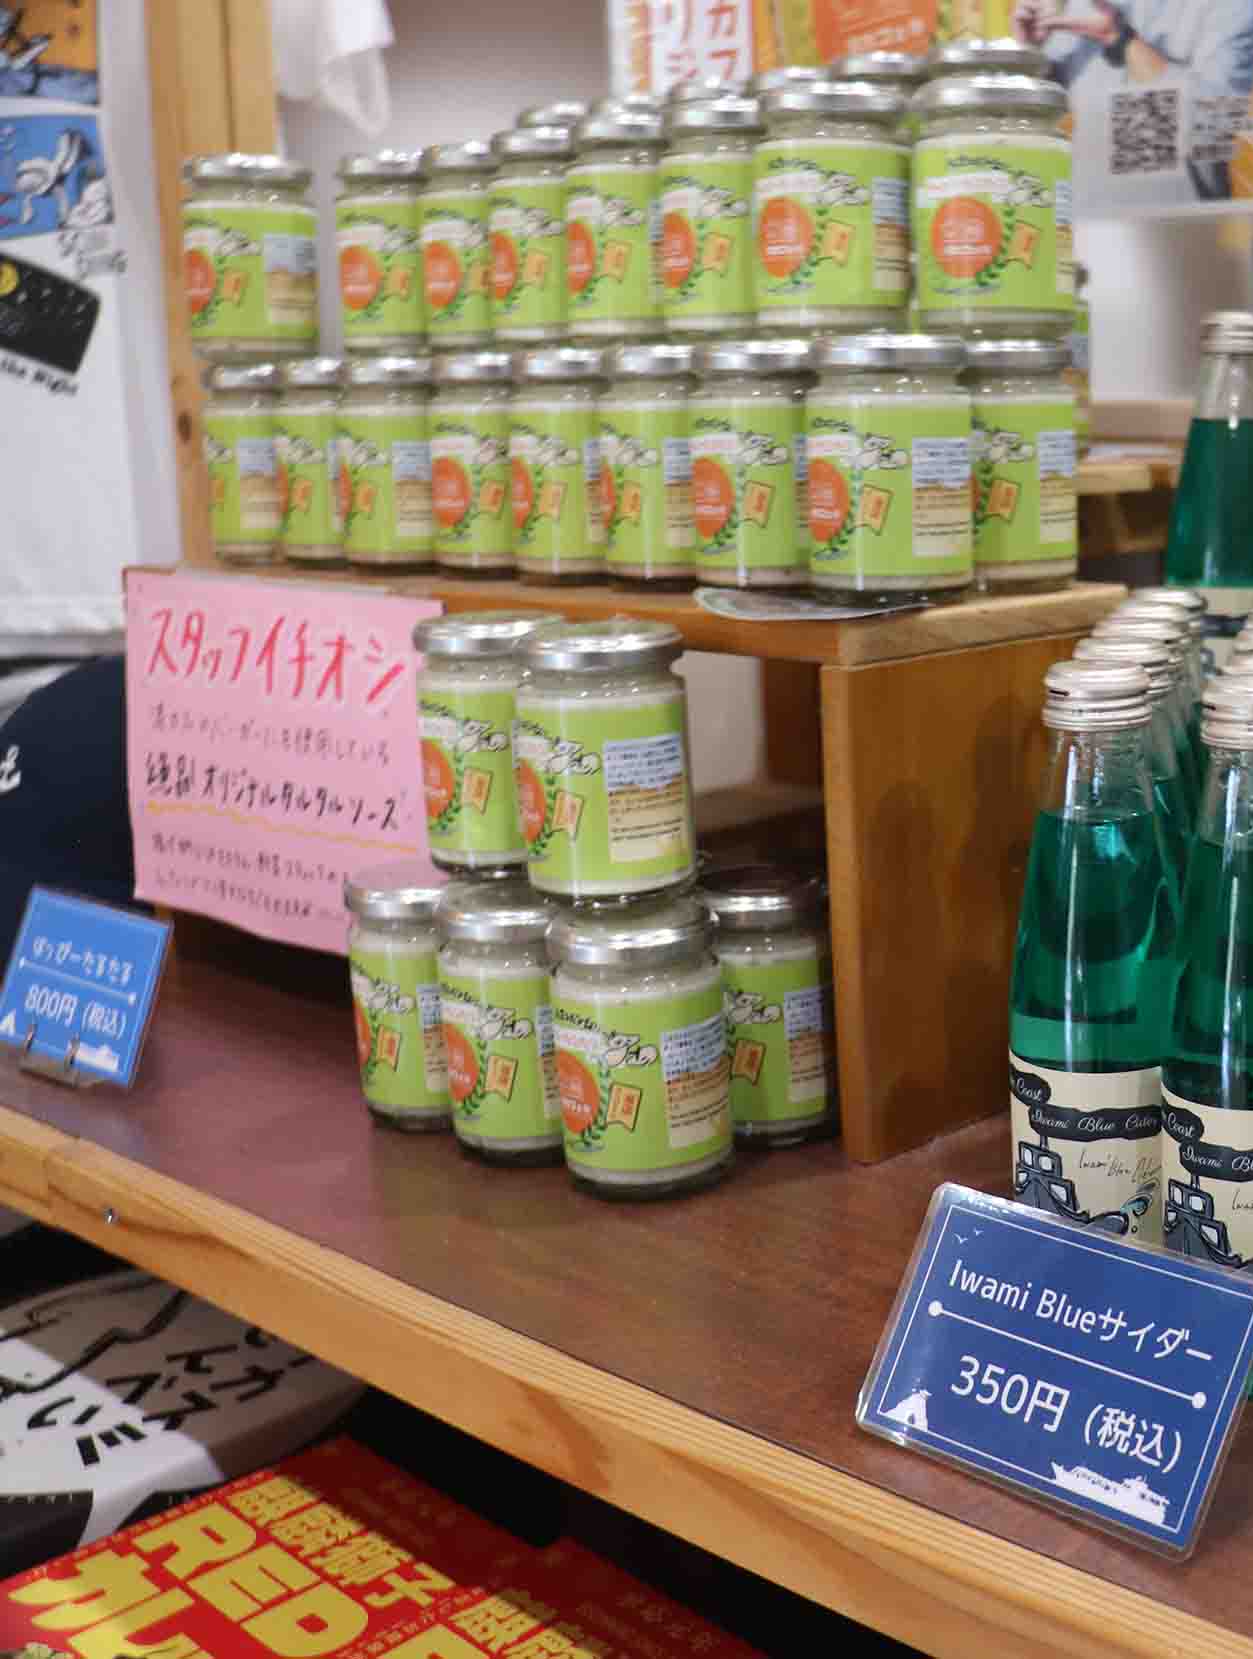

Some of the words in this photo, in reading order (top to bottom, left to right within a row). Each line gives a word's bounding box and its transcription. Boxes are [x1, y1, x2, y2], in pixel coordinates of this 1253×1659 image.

[149, 608, 405, 704] スタッフイチオシ
[1015, 1077, 1043, 1101] Coast
[1078, 1115, 1116, 1133] Blue
[1166, 1112, 1196, 1138] Coast
[949, 1260, 1032, 1313] Iwami
[1036, 1288, 1214, 1362] Blueサイダー
[950, 1355, 1071, 1433] 350円
[131, 1502, 369, 1657] RED
